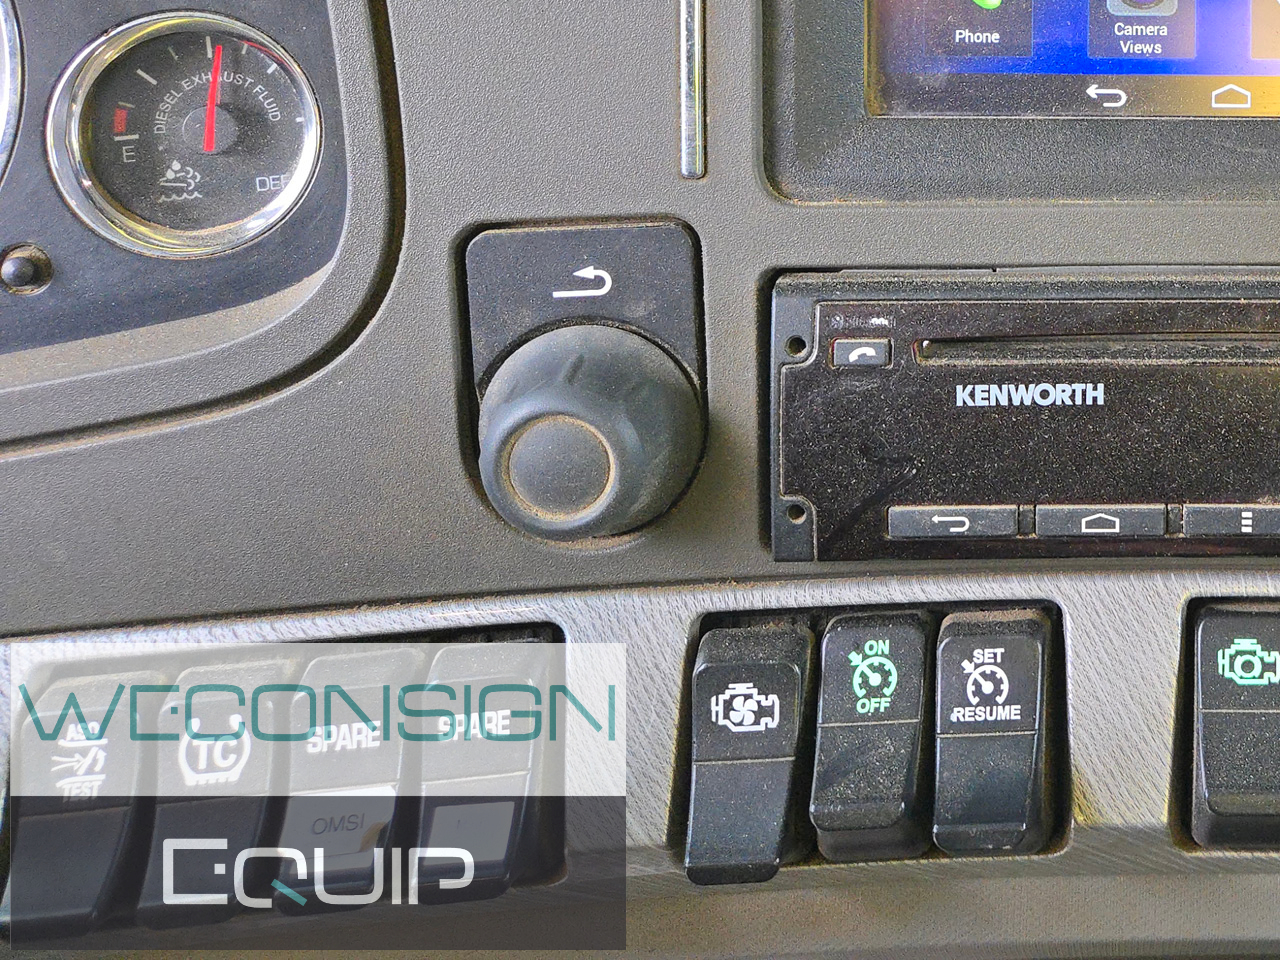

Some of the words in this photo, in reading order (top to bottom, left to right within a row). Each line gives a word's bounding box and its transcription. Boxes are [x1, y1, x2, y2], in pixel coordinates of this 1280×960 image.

[955, 29, 1000, 43] Phone
[1114, 22, 1168, 36] Camera
[1120, 41, 1162, 54] Views
[181, 70, 255, 91] EXHUST
[154, 89, 183, 135] DIESEL
[252, 85, 281, 123] FLUID
[122, 145, 137, 163] E
[956, 383, 1105, 407] KENWORTH
[864, 640, 890, 656] ON
[972, 648, 1005, 664] SET
[856, 697, 892, 714] OFF
[952, 705, 1021, 723] RESUME
[438, 709, 511, 740] SPARE
[306, 720, 381, 754] SPARE
[192, 735, 238, 770] TC
[62, 781, 103, 803] TEST
[312, 813, 365, 836] OMSI
